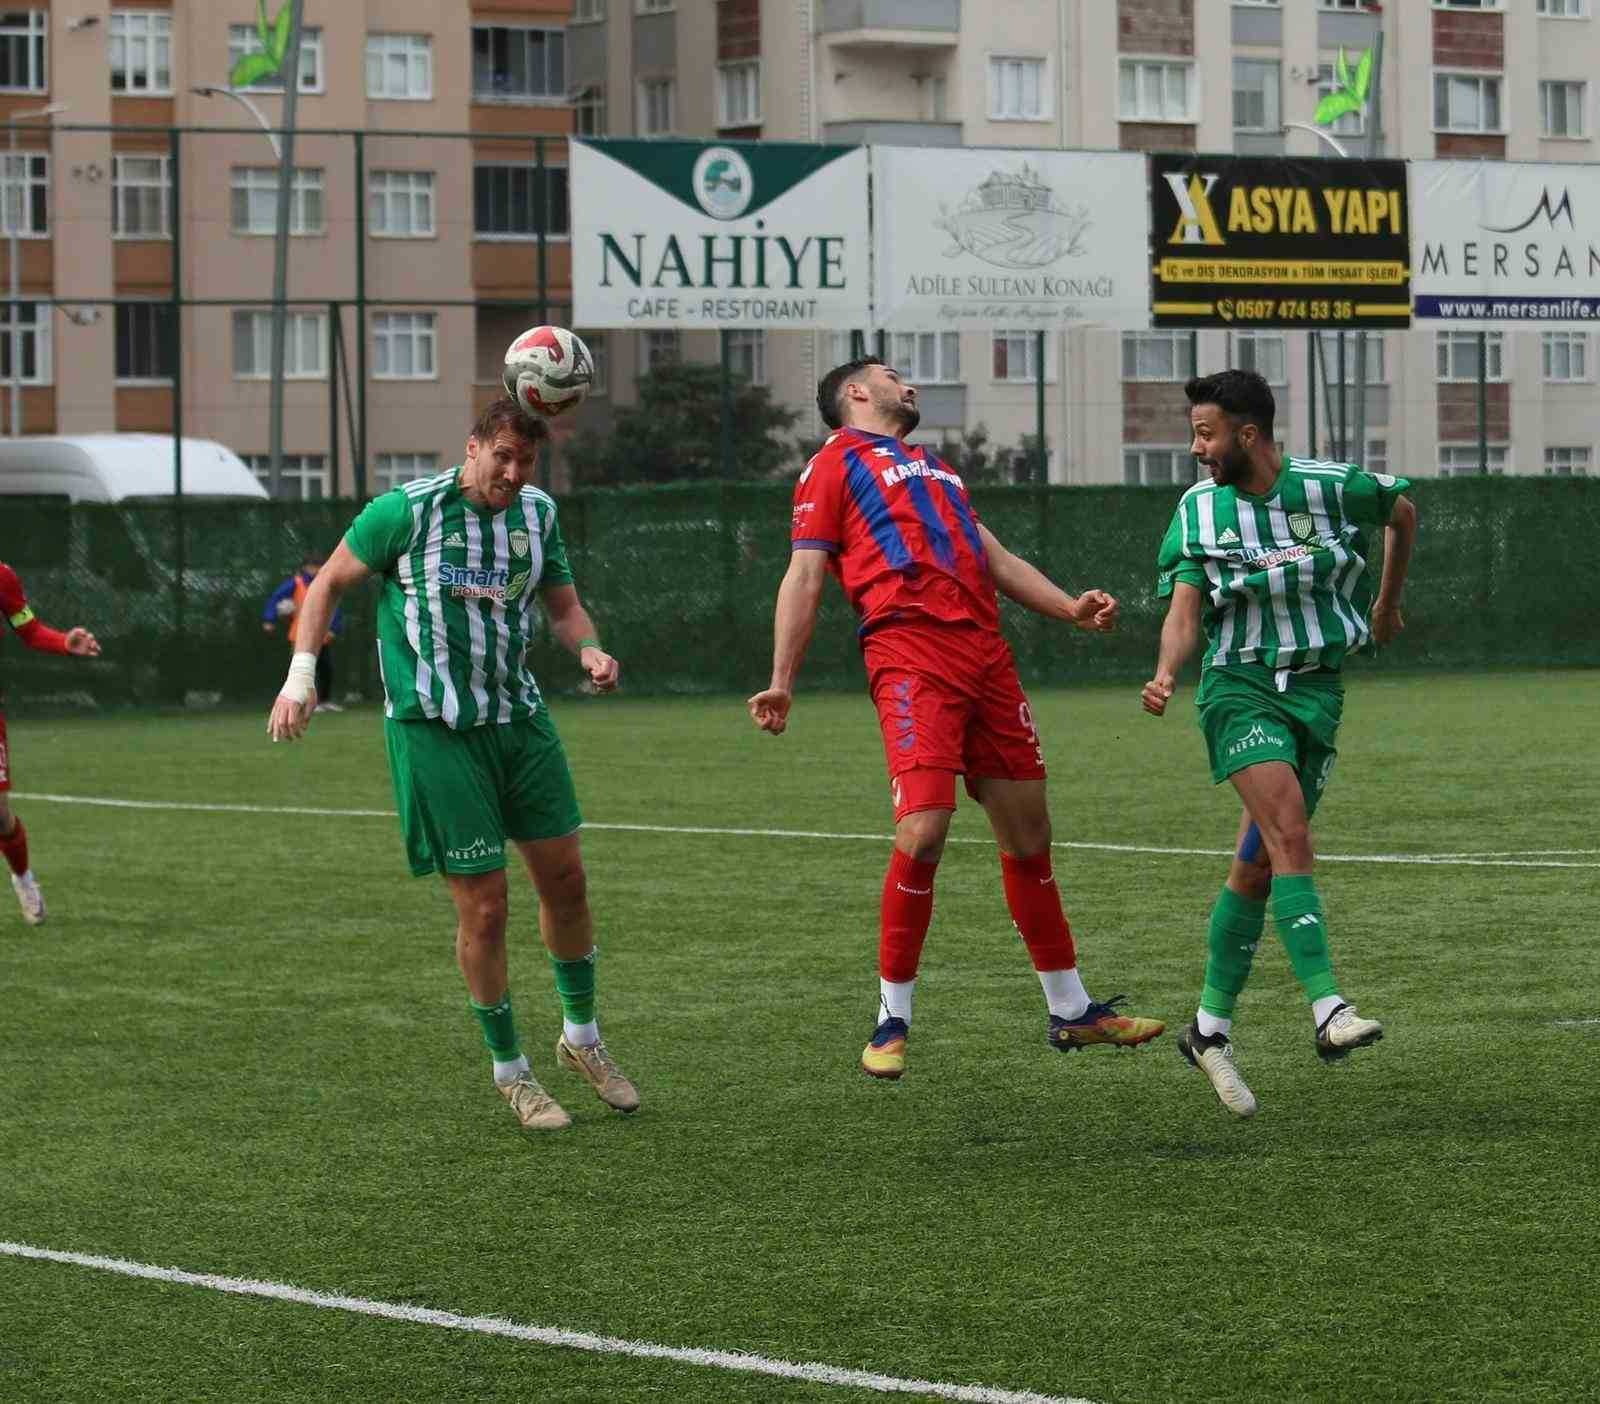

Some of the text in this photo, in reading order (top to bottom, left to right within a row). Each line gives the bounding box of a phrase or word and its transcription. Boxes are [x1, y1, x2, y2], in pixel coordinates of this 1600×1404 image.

[1227, 187, 1401, 235] ASYA YAPI
[597, 219, 846, 290] NAHİYE
[1421, 242, 1600, 278] MERSAN
[1218, 265, 1288, 279] DEKORASYON
[905, 272, 1113, 298] ADİLE SULTAN KONAĞI
[628, 299, 679, 319] CAFE
[702, 299, 817, 319] RESTORANT
[1236, 301, 1351, 320] 0507 474 53 36
[1257, 548, 1306, 568] OLDING
[438, 563, 508, 587] Smart
